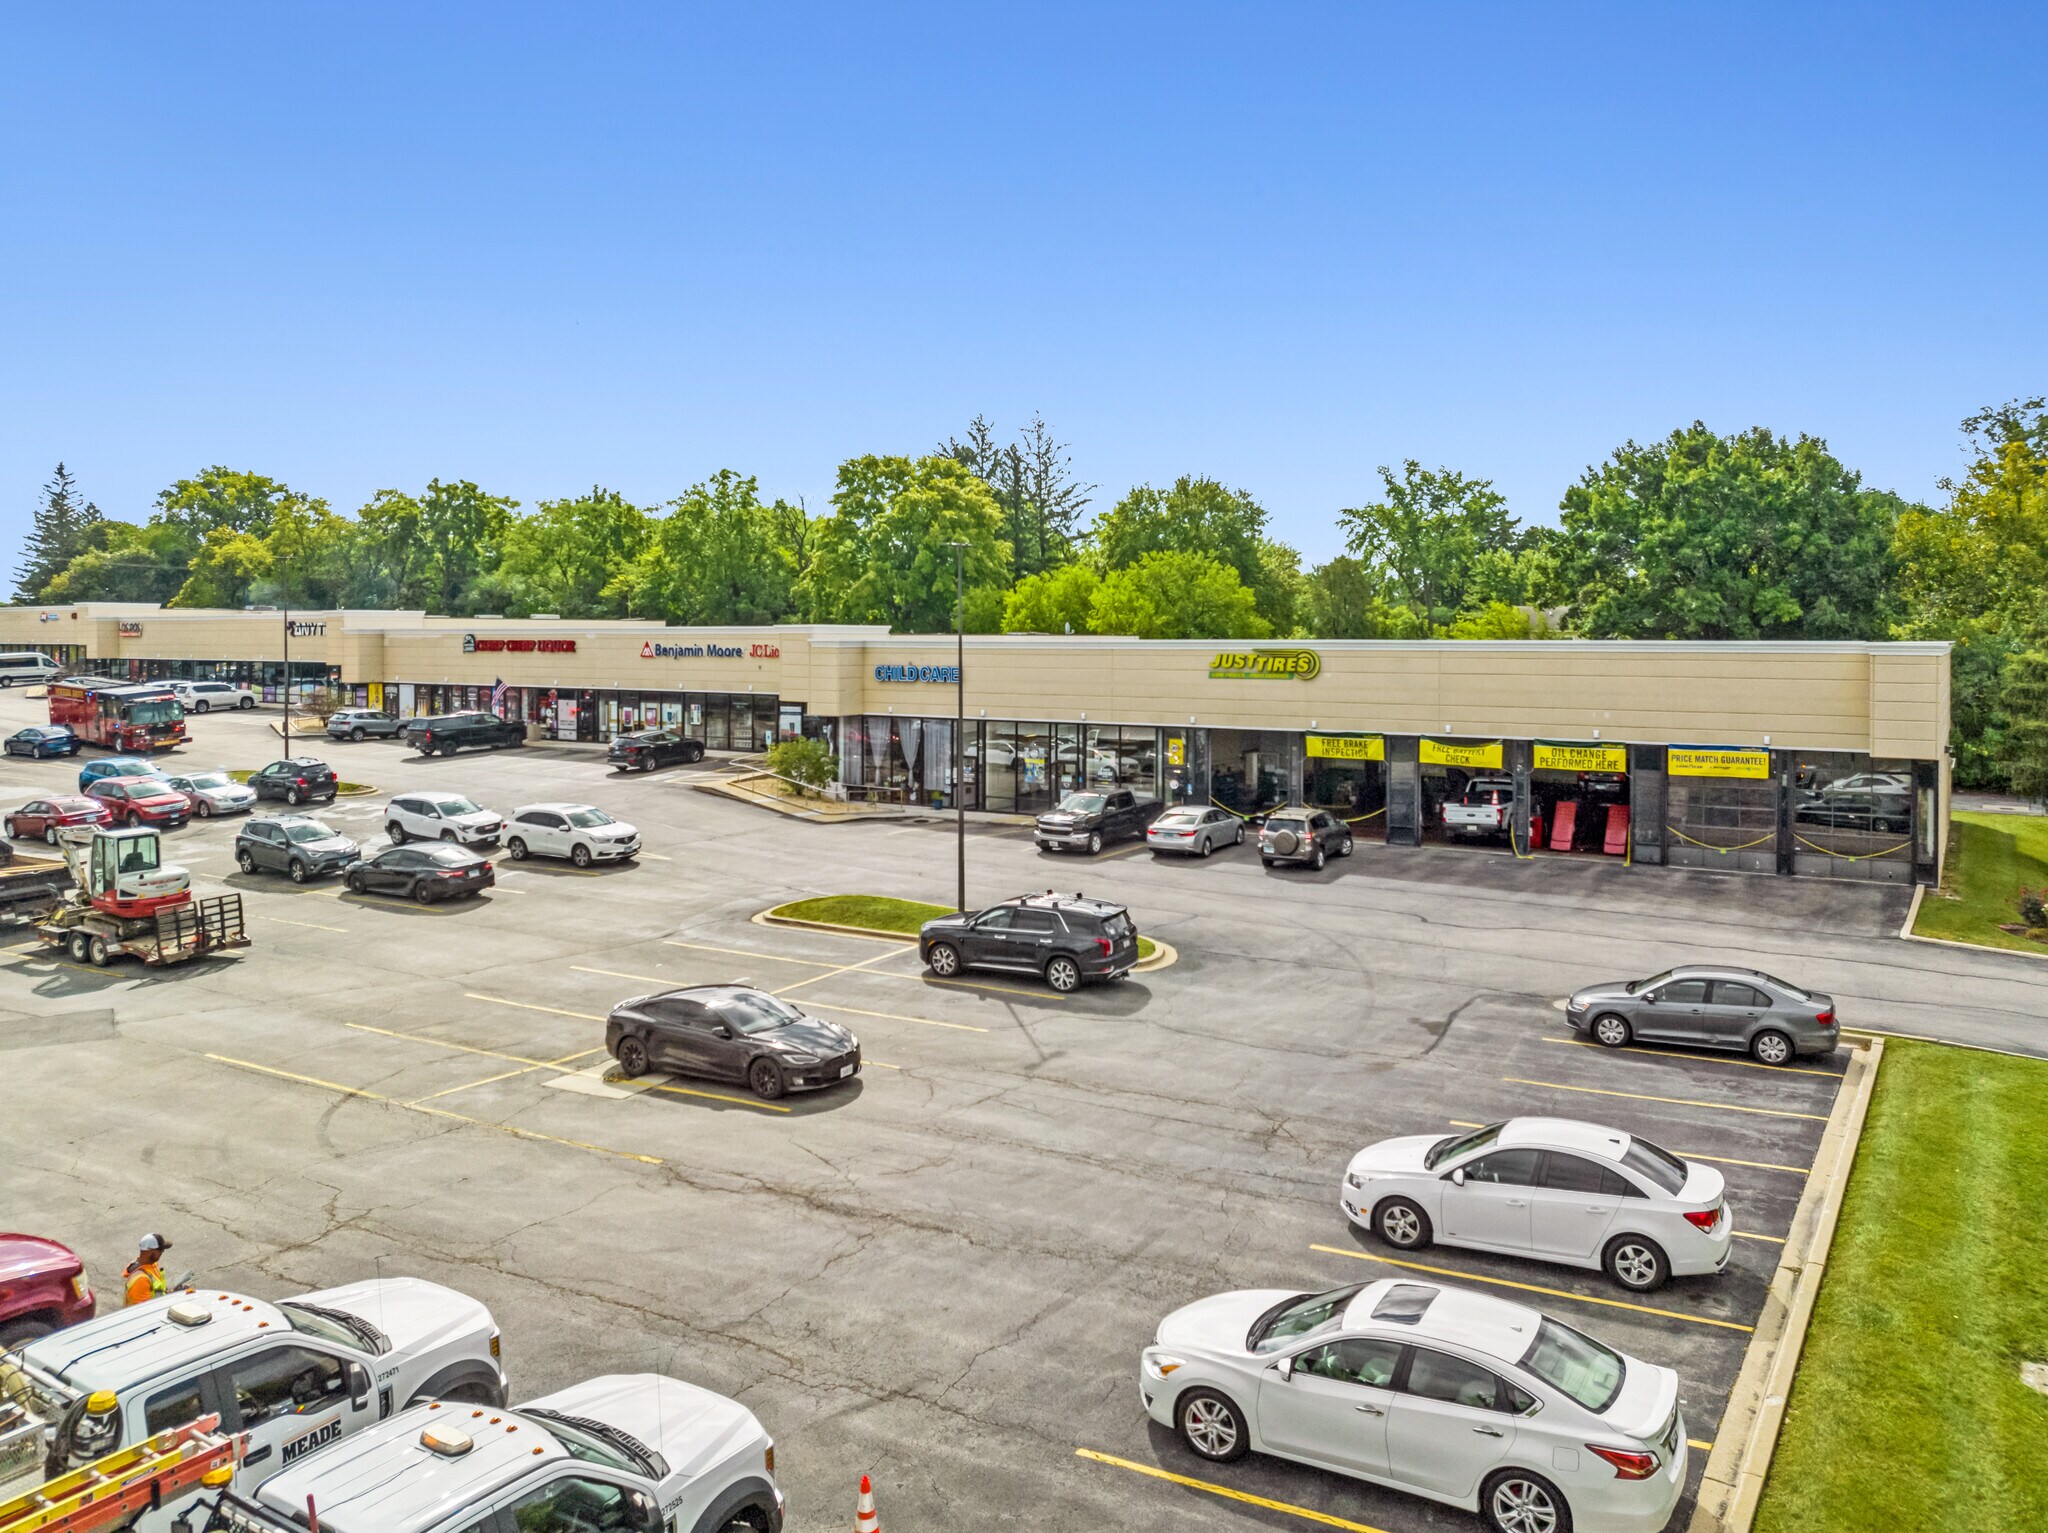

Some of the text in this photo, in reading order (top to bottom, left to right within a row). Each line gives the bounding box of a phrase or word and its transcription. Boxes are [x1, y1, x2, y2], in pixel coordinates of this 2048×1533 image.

[655, 643, 743, 660] Benjamin Moore
[1209, 653, 1311, 673] JUST TIRES
[874, 665, 959, 683] CHILD CARE
[1321, 738, 1368, 749] FREE BRAKE
[1432, 744, 1451, 754] FREE
[1321, 748, 1369, 758] INSPECTION
[1445, 754, 1470, 764] CHECK
[1551, 748, 1607, 760] OIL CHANGE
[1540, 757, 1619, 770] PERFORMED HERE
[1671, 754, 1766, 766] PRICE MATCH GUARANTEE!
[377, 1366, 400, 1382] 272471
[281, 1419, 342, 1464] MEADE
